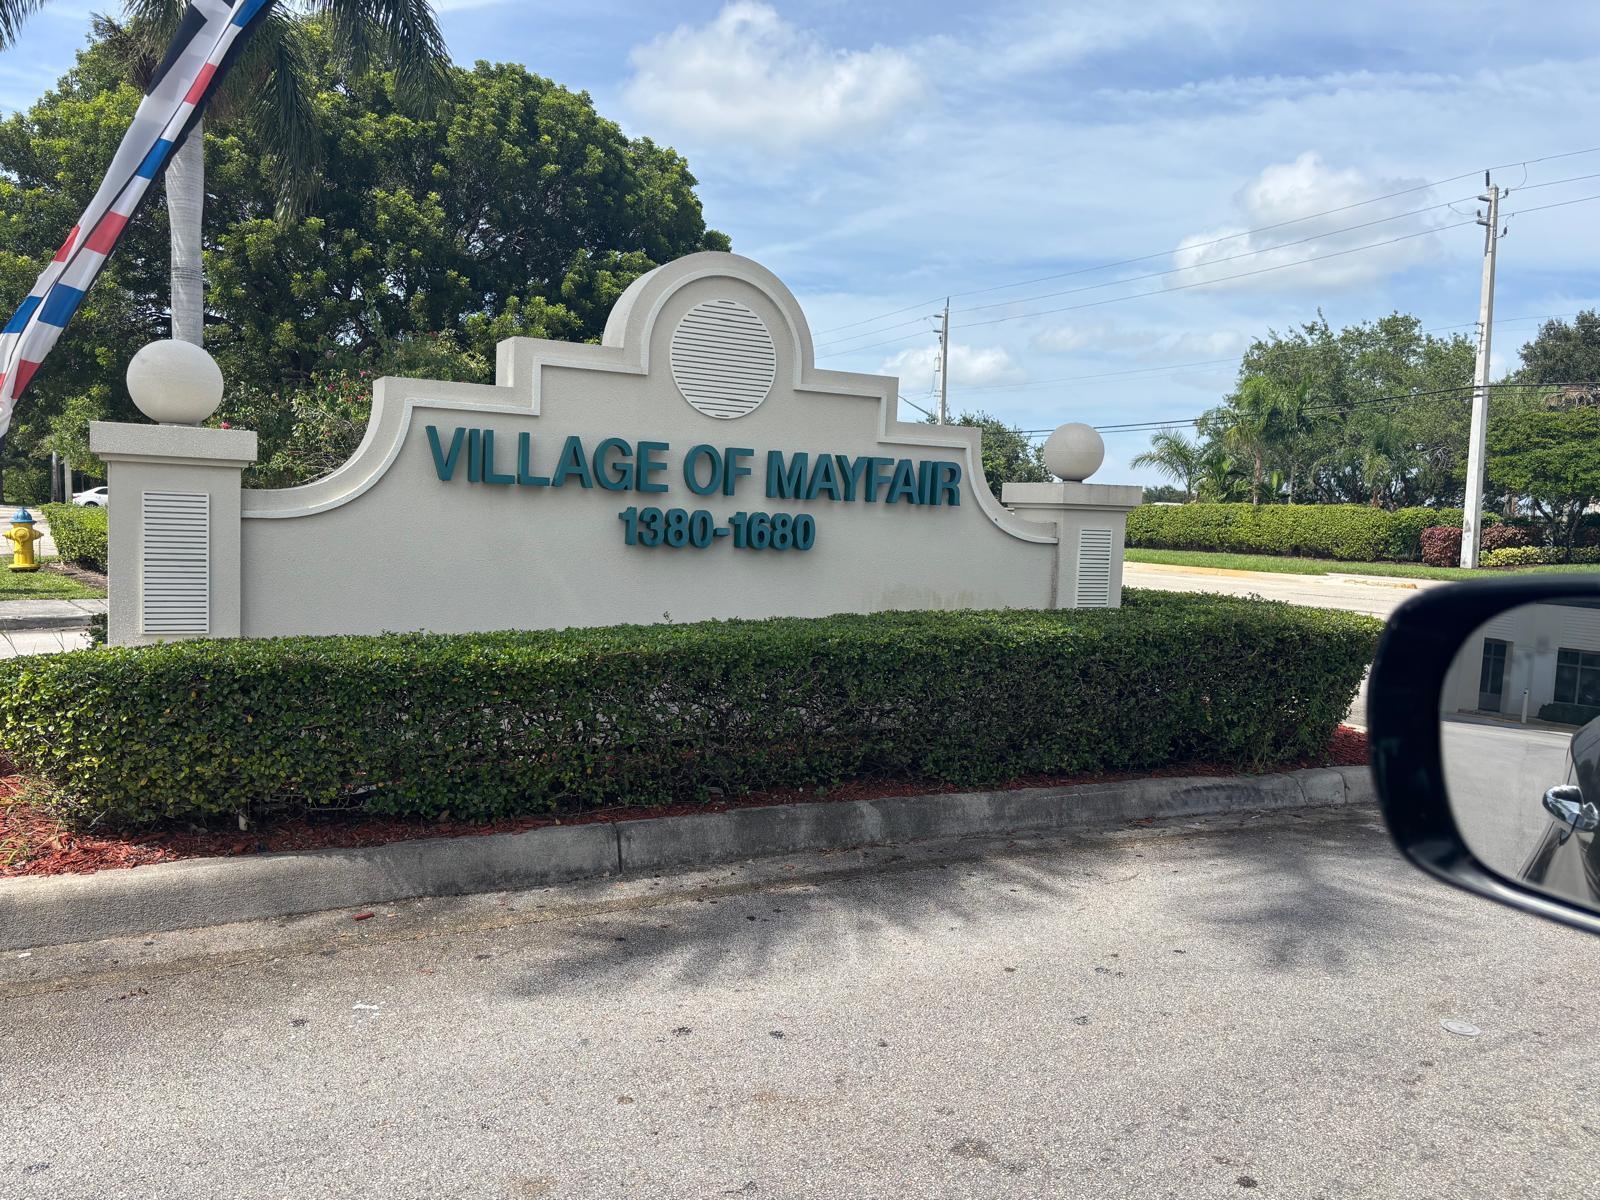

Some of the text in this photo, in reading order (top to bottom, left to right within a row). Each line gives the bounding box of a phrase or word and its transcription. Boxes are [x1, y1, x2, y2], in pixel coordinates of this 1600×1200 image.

[425, 425, 962, 506] VILLAGE OF MAYFAIR
[619, 506, 817, 551] 1380-1680
